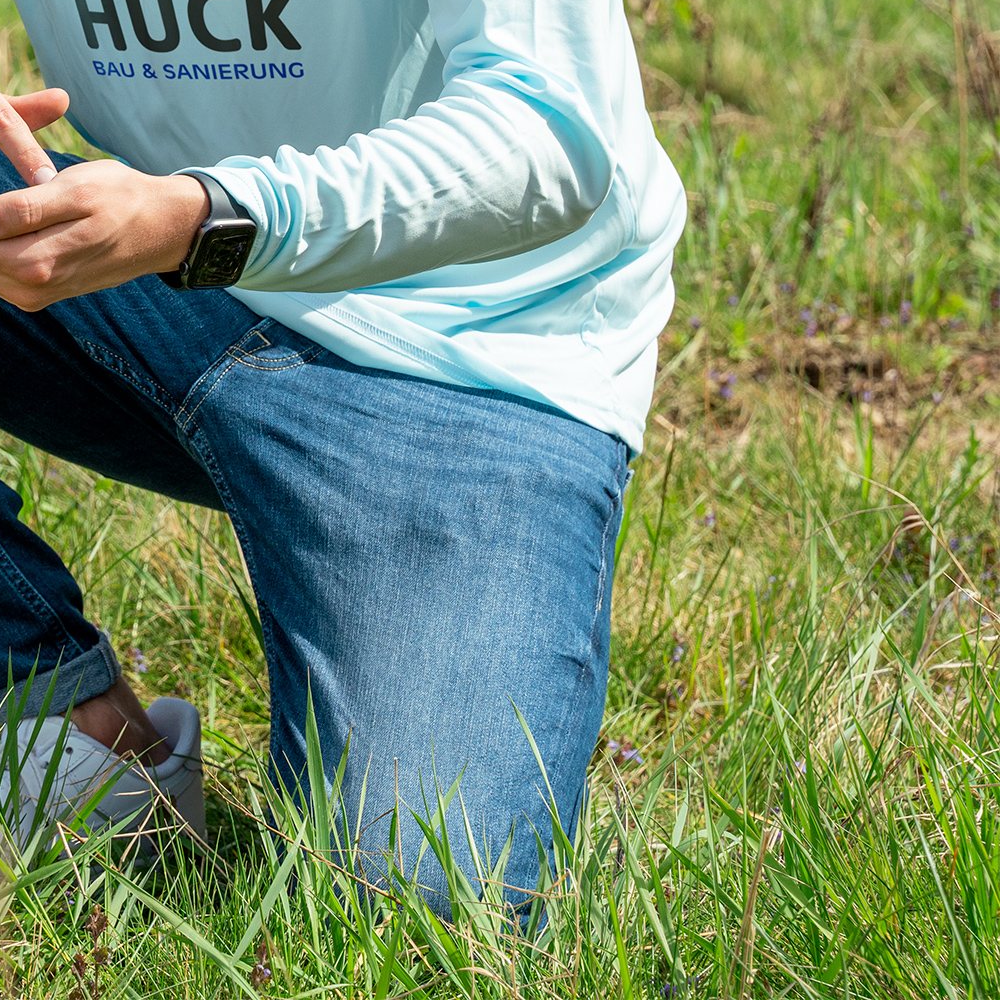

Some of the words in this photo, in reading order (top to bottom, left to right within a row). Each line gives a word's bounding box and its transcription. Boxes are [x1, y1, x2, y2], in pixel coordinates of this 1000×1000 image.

[92, 60, 135, 78] BAU
[142, 63, 158, 79] &
[162, 62, 305, 80] SANIERUNG
